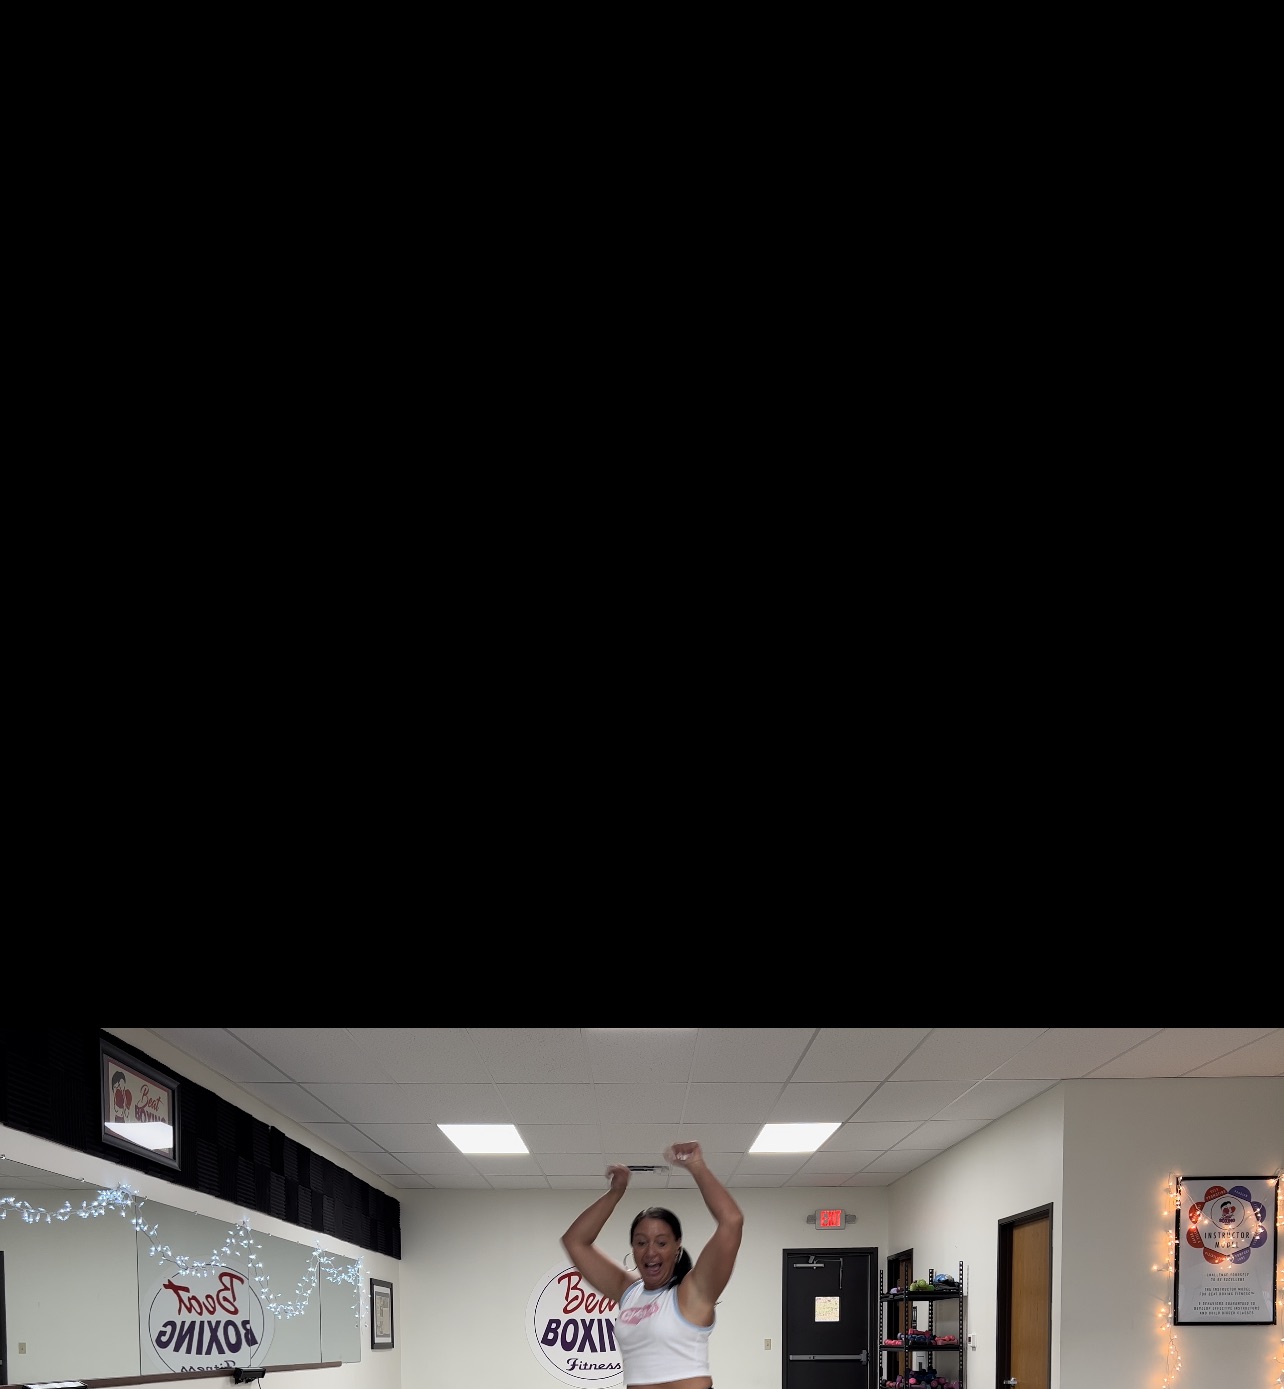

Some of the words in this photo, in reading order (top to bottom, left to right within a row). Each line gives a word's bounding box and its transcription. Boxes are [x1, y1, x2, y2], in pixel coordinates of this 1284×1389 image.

[137, 1084, 163, 1111] Beat
[820, 1209, 841, 1227] EXIT
[1204, 1231, 1250, 1239] INSTRUCTOR
[557, 1271, 618, 1315] Bea
[540, 1318, 618, 1353] BOXIN
[566, 1357, 622, 1371] Fitness
